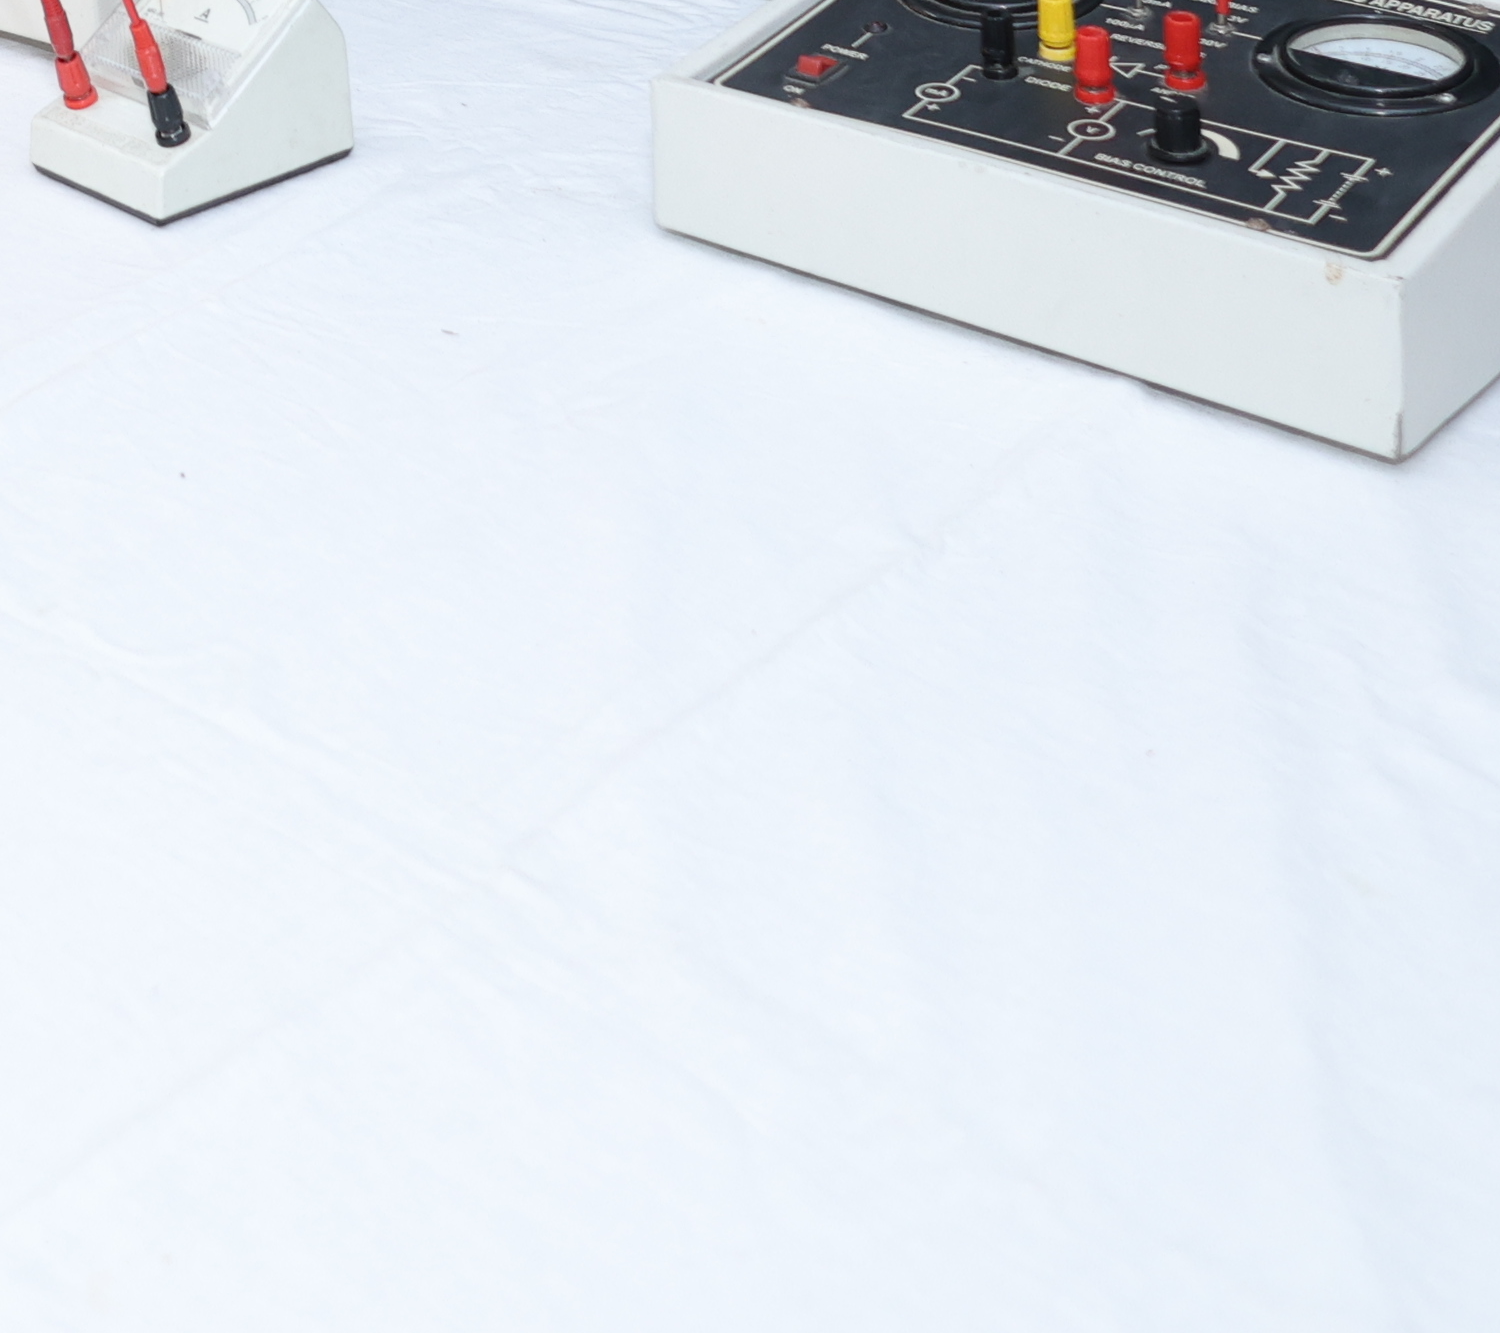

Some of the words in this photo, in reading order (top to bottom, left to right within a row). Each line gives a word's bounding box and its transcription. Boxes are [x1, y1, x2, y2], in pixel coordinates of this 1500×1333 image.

[1109, 32, 1167, 51] REVERS
[820, 42, 871, 61] POWER
[1017, 55, 1073, 74] CATHODE
[1023, 75, 1072, 93] DIODE
[1093, 151, 1141, 171] BIAS
[1130, 160, 1208, 190] CONTROL
